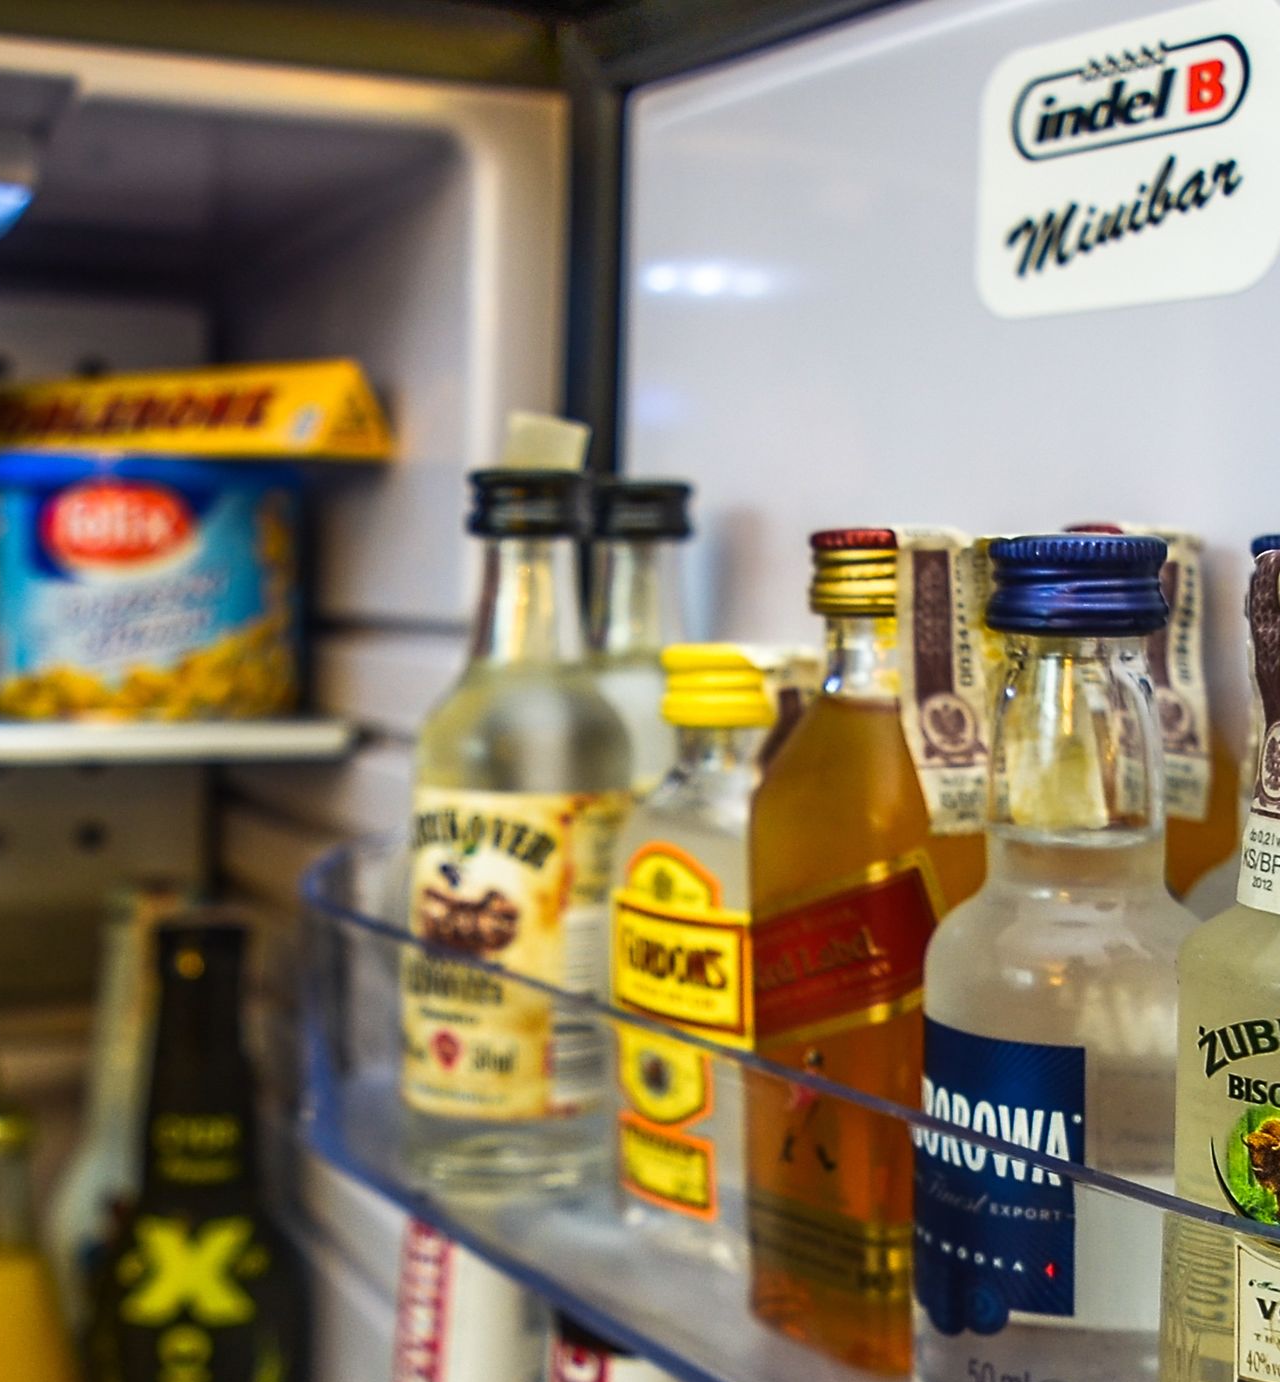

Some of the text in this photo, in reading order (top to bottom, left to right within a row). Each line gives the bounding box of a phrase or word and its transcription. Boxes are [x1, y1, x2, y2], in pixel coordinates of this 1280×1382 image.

[1035, 59, 1226, 144] indel B
[1005, 154, 1243, 279] Minibar
[989, 1202, 1063, 1221] EXPORT
